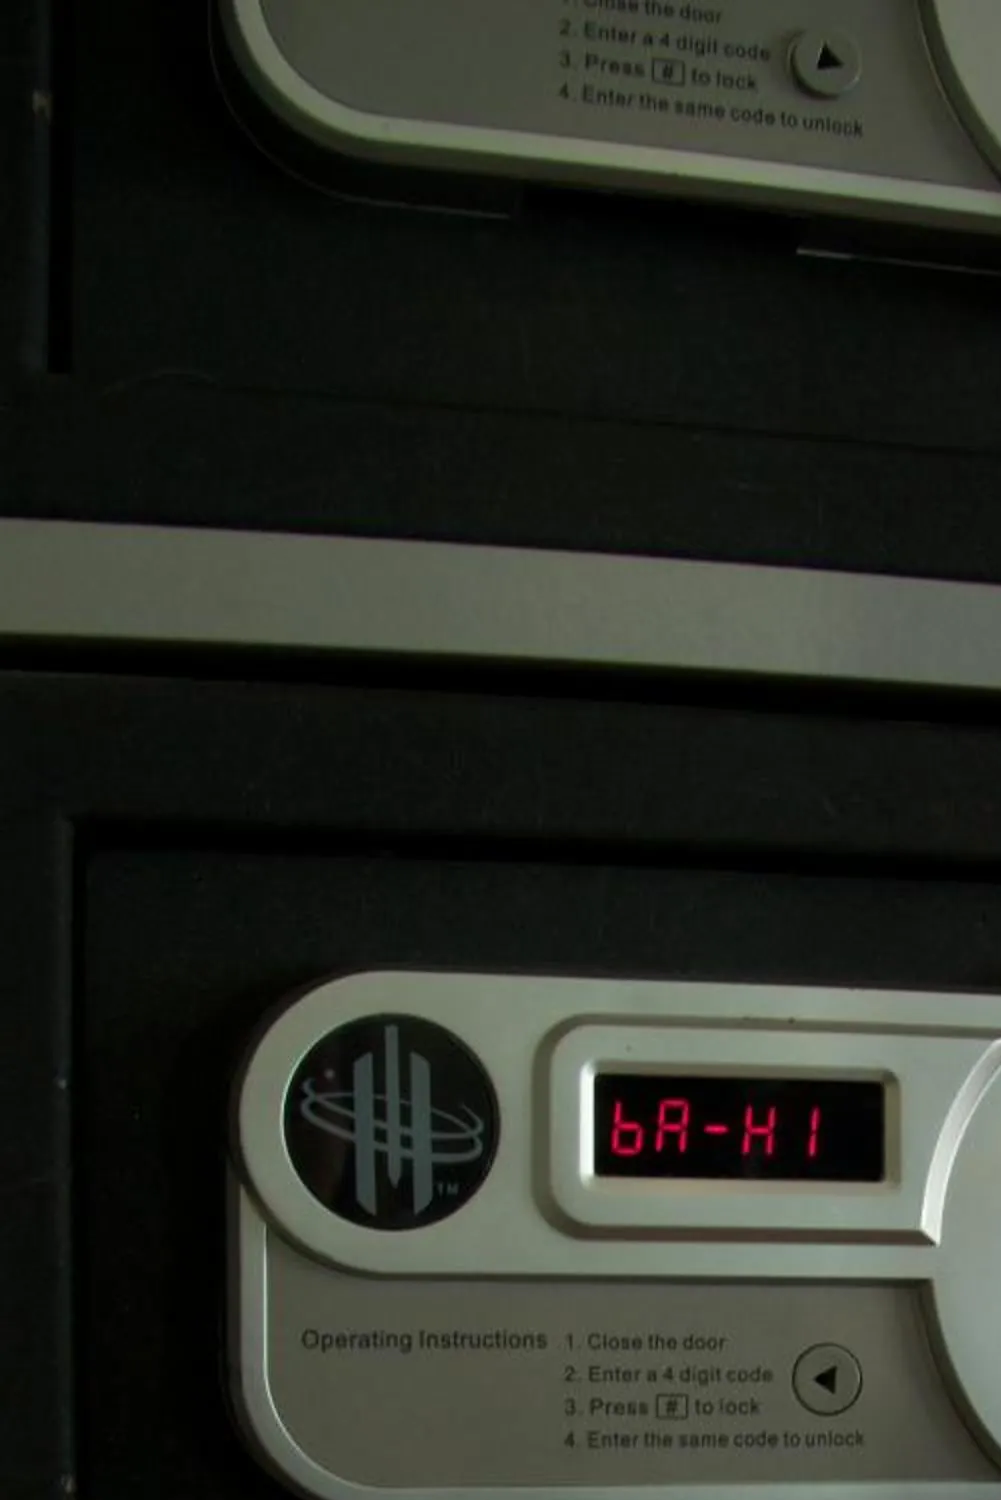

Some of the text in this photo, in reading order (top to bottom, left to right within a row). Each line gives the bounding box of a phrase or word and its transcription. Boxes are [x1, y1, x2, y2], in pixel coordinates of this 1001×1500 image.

[646, 0, 674, 17] the
[680, 3, 721, 23] door
[584, 20, 636, 44] Enter
[644, 33, 653, 46] a
[660, 32, 670, 47] 4
[676, 35, 717, 57] digit
[724, 42, 770, 61] code
[585, 51, 645, 77] Press
[691, 67, 711, 85] to
[717, 71, 757, 91] lock
[582, 83, 632, 107] Enter
[639, 92, 669, 112] the
[674, 100, 726, 118] same
[730, 106, 775, 125] code
[781, 111, 798, 128] to
[802, 115, 863, 136] unlock
[301, 1328, 548, 1354] Operating Instructions
[588, 1332, 643, 1350] Close
[648, 1333, 677, 1350] the
[683, 1333, 725, 1350] door
[588, 1365, 640, 1382] Enter
[647, 1370, 657, 1382] a
[662, 1366, 674, 1382] 4
[679, 1366, 721, 1385] digit
[726, 1366, 773, 1382] code
[590, 1398, 648, 1416] Press
[695, 1400, 714, 1415] to
[719, 1398, 760, 1415] lock
[587, 1430, 639, 1448] Enter
[644, 1431, 673, 1448] the
[679, 1434, 729, 1448] same
[733, 1431, 778, 1448] code
[784, 1432, 801, 1448] to
[805, 1430, 864, 1447] unlock
